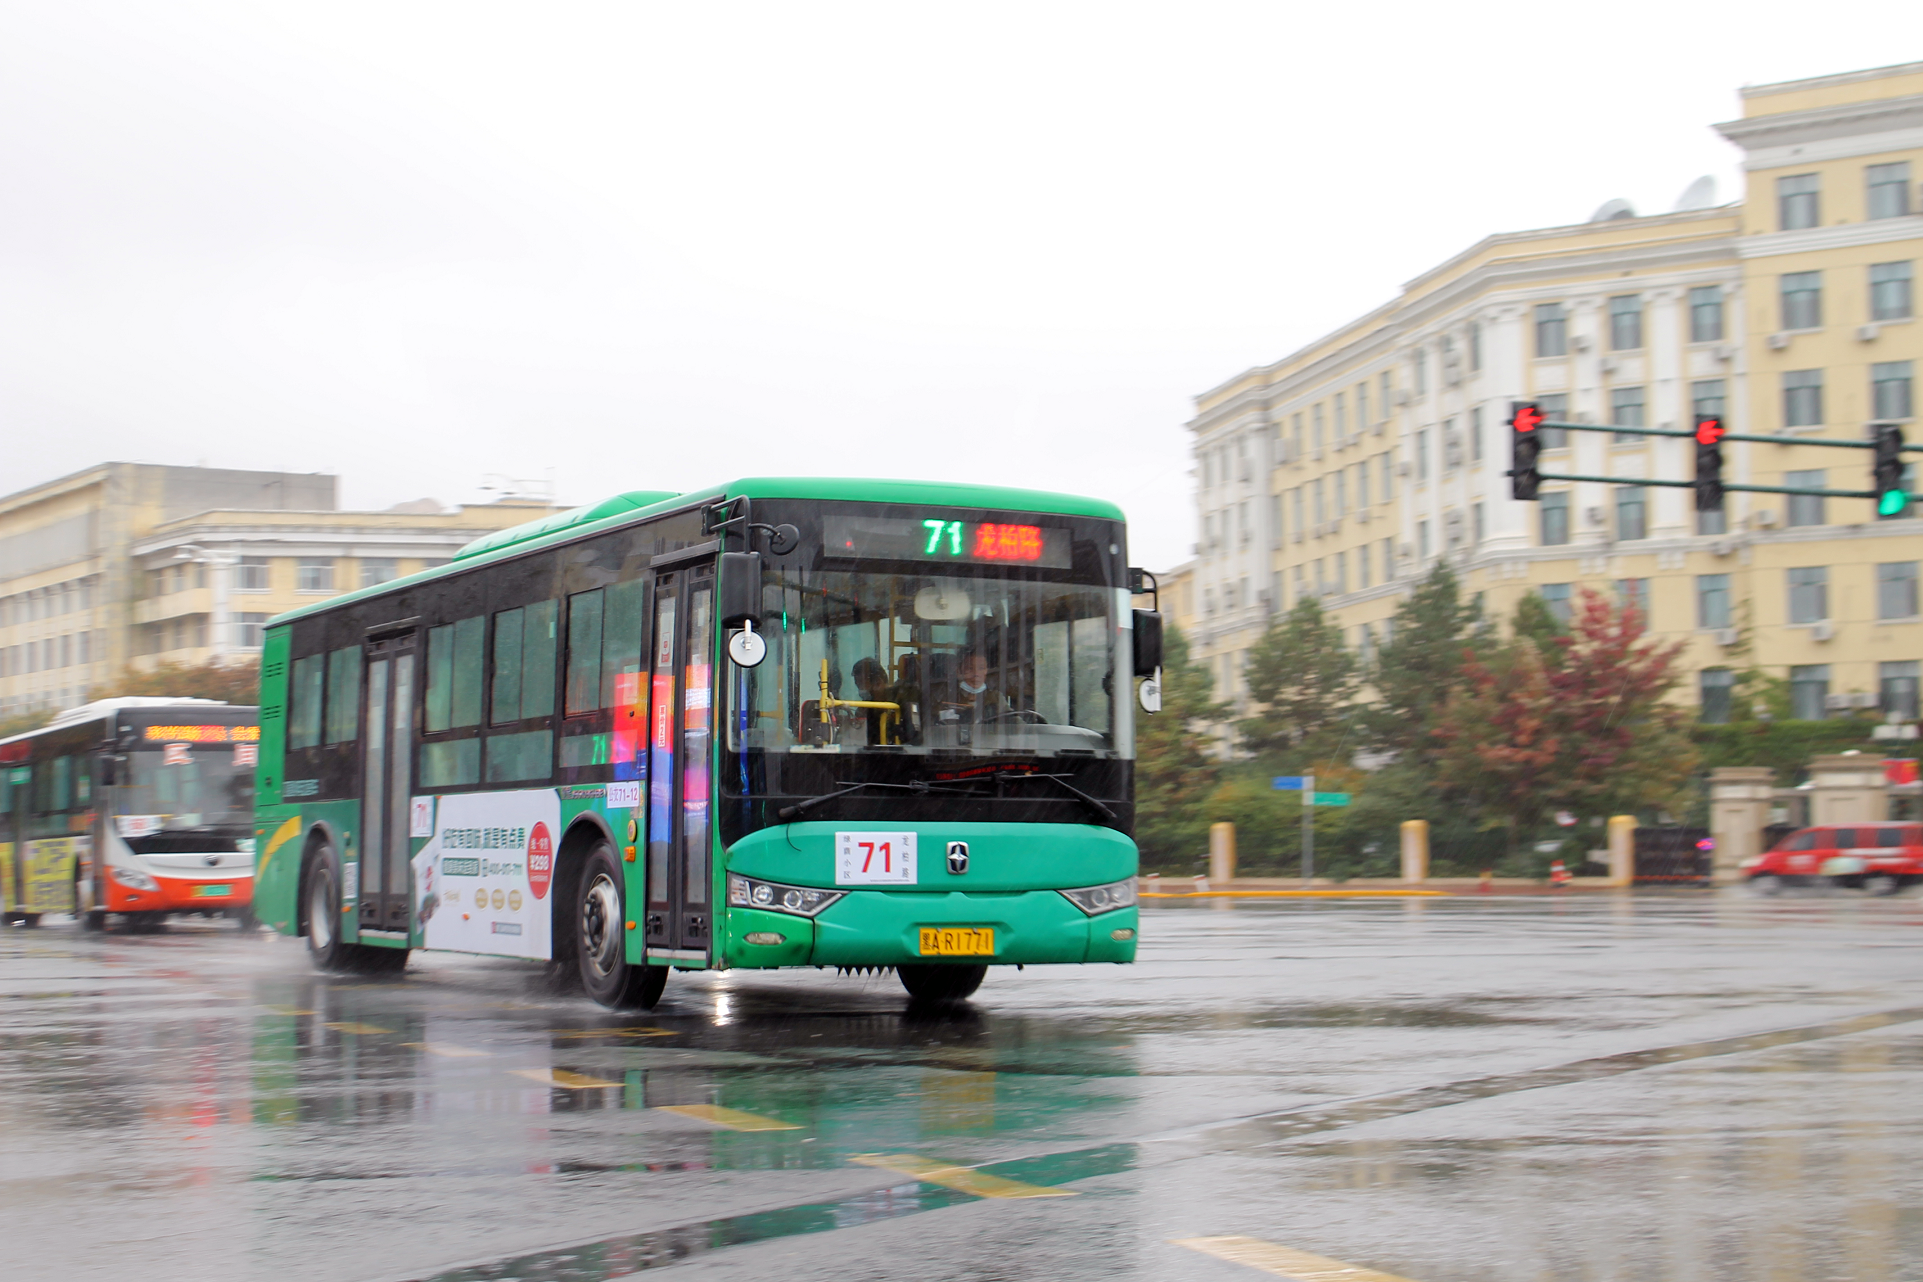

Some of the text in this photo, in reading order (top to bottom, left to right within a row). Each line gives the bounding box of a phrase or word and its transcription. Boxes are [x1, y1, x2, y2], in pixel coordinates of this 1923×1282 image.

[923, 519, 963, 555] 71
[592, 735, 606, 765] 71
[858, 842, 891, 873] 71
